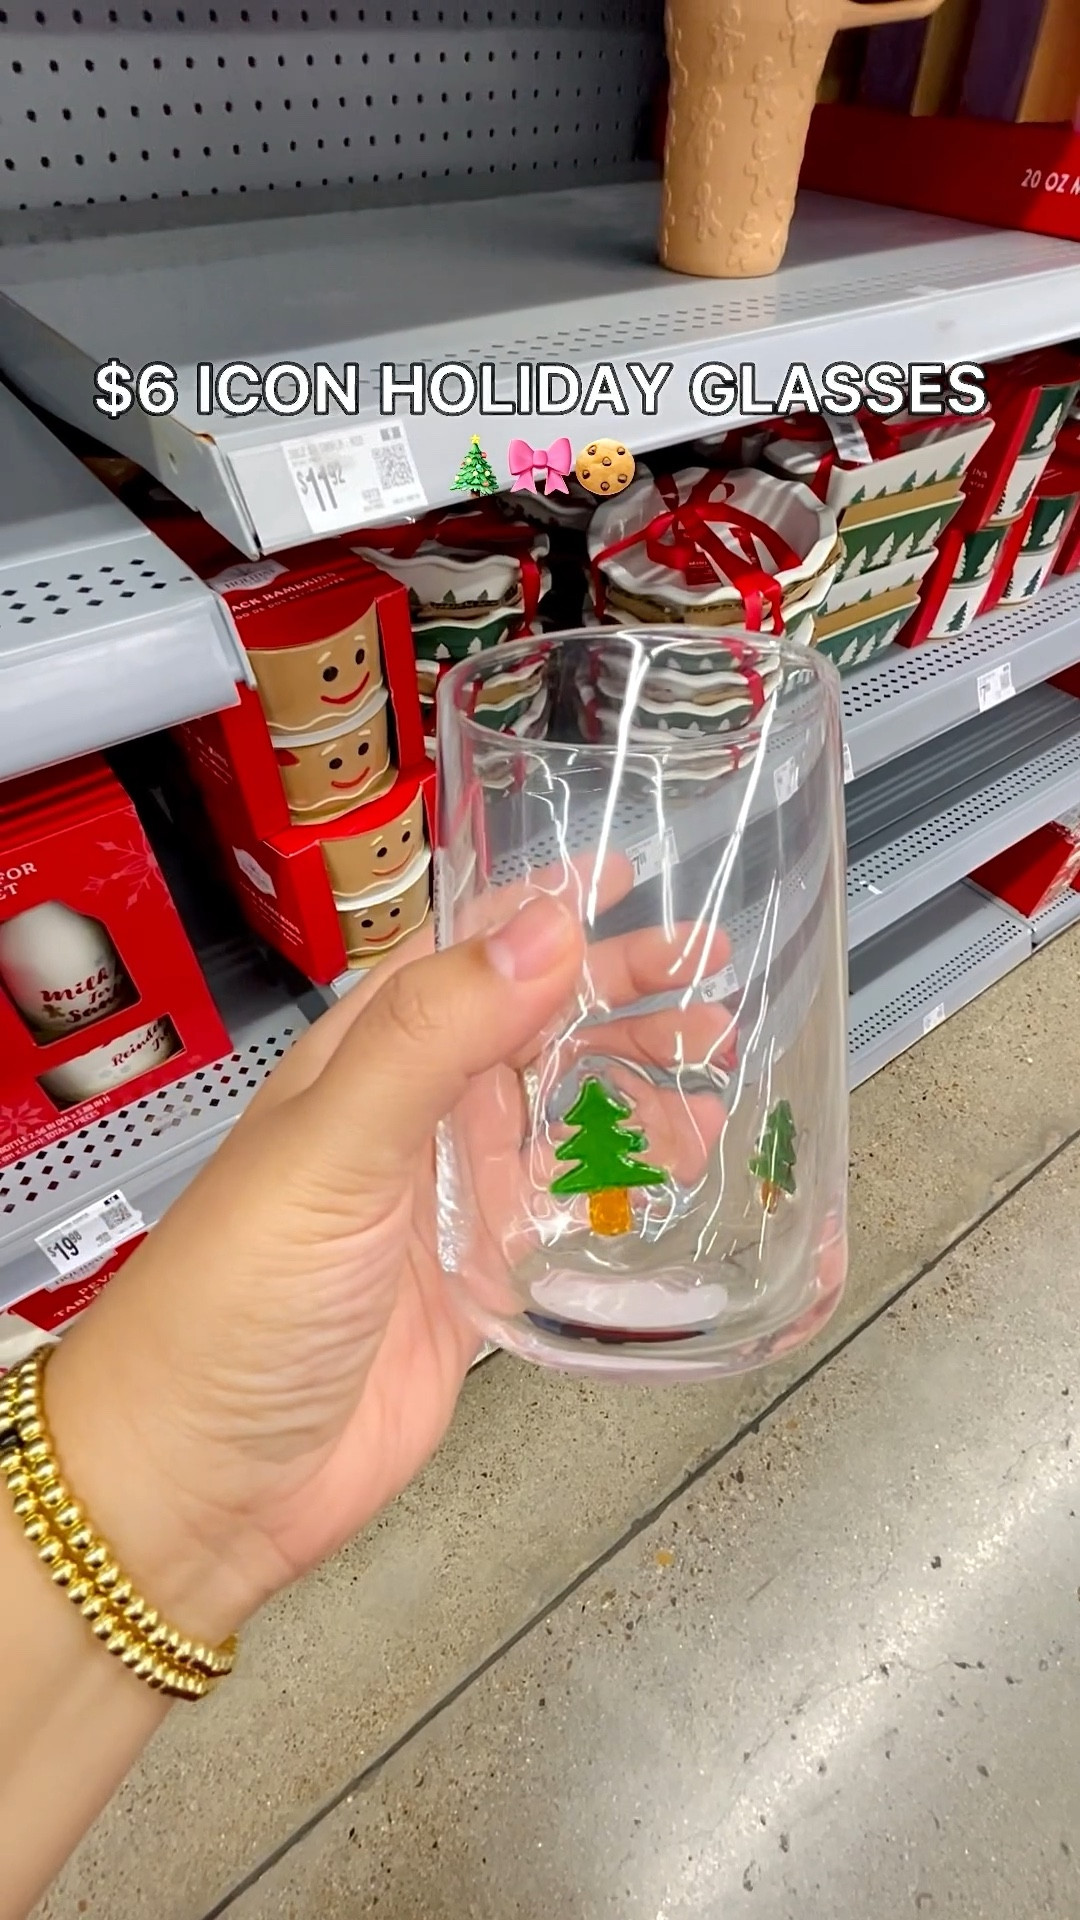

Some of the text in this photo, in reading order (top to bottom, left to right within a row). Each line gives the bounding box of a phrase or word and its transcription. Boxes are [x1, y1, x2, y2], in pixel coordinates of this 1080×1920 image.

[1021, 168, 1042, 188] 20
[1045, 172, 1070, 193] OZ
[44, 1125, 69, 1141] TOTAL
